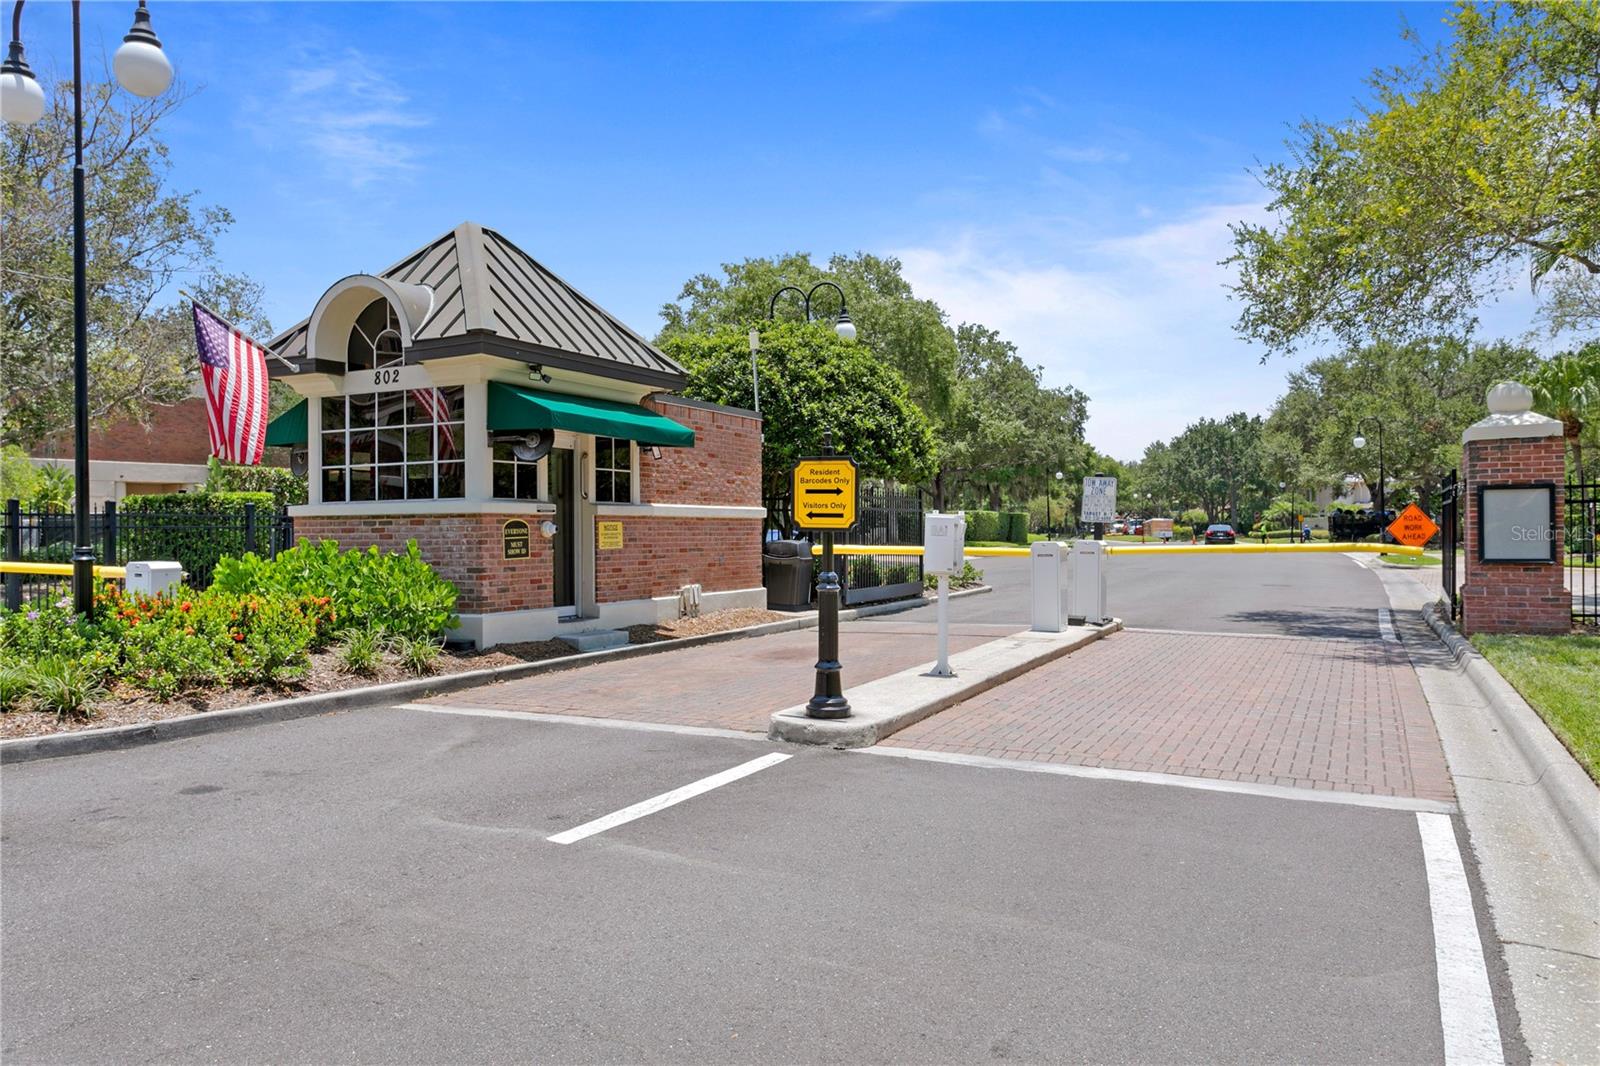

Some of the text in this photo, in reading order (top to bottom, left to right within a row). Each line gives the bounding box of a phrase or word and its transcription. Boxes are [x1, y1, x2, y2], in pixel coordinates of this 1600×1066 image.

[374, 369, 400, 385] 802
[809, 468, 841, 476] Resident
[800, 476, 850, 485] Barcodes Only
[1098, 479, 1114, 488] AWAY
[1091, 486, 1106, 496] ZONE
[830, 502, 847, 511] Only
[1402, 533, 1426, 541] AHEAD
